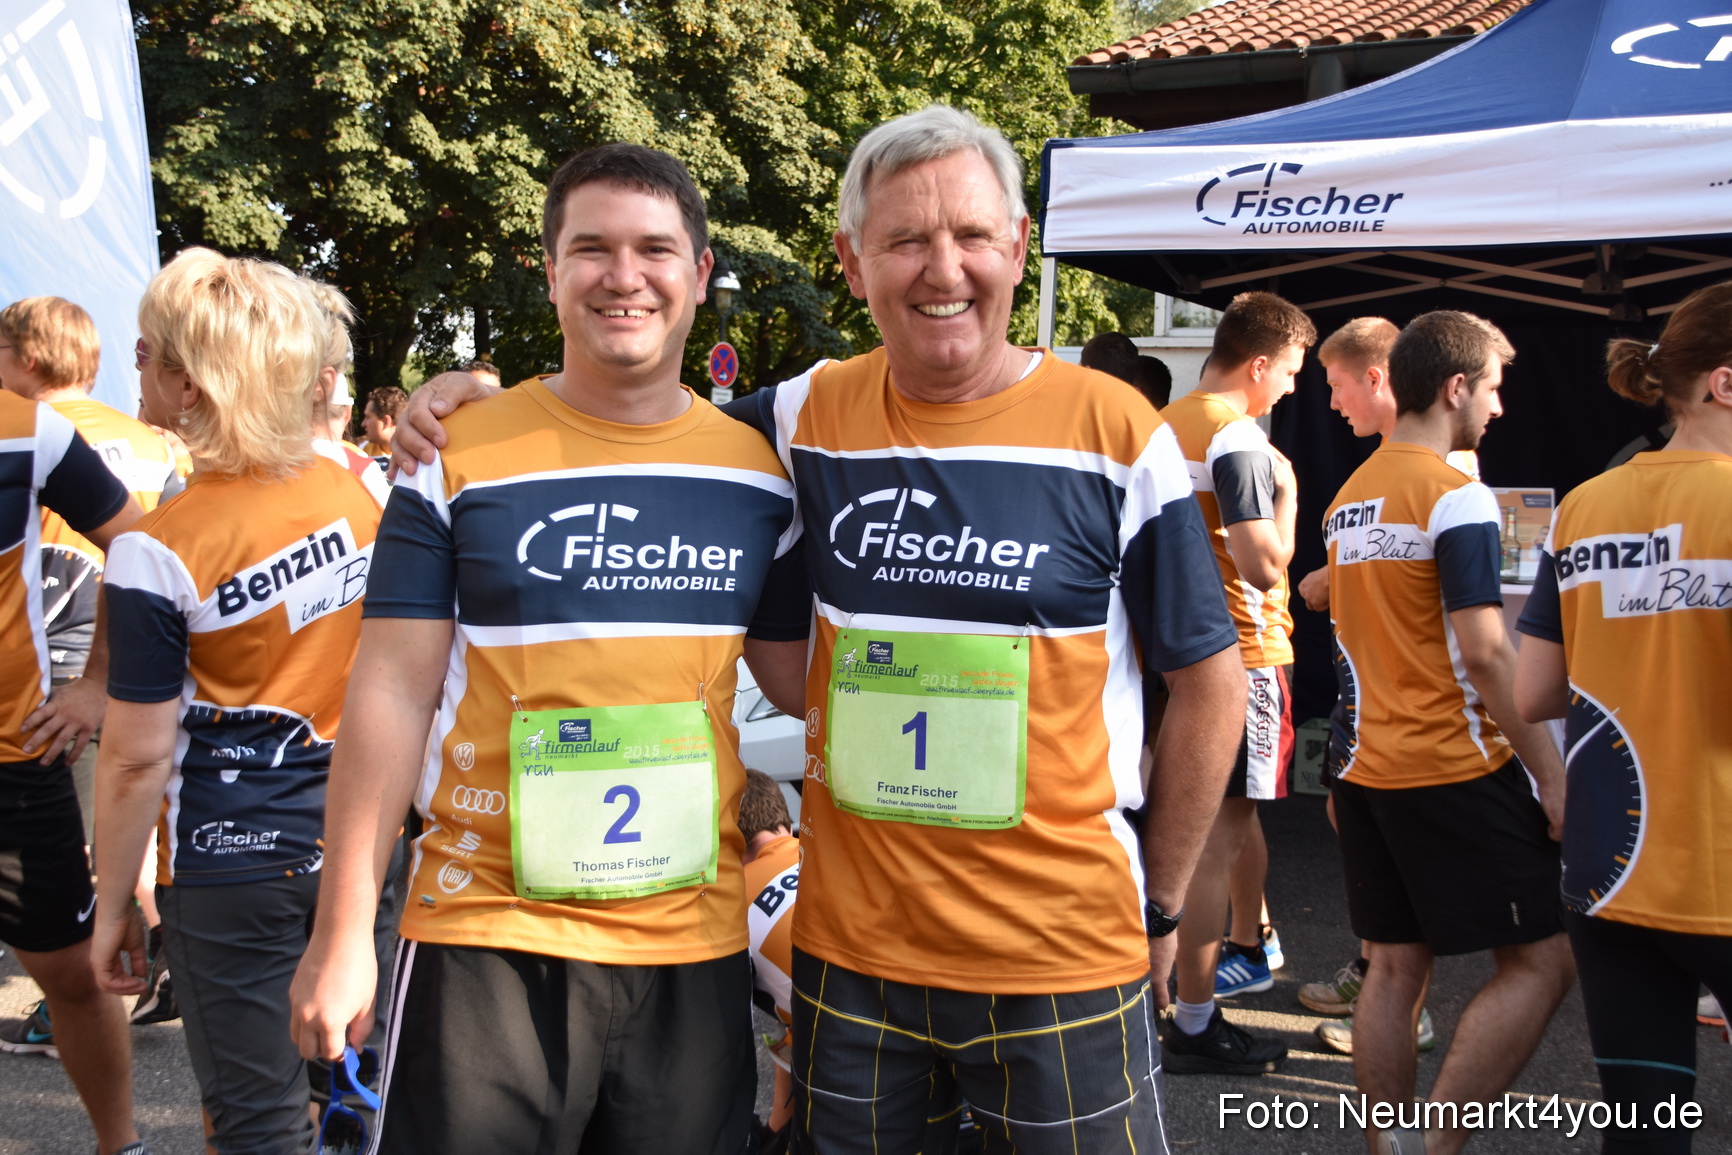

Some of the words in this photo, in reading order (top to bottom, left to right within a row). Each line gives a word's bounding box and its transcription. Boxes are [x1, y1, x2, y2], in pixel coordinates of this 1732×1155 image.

[1230, 187, 1404, 218] Fischer
[1242, 219, 1385, 234] AUTOMOBILE
[562, 536, 743, 571] Fischer
[858, 522, 1049, 569] Fischer
[1360, 528, 1421, 560] Blut
[1554, 532, 1670, 582] Benzin
[217, 530, 347, 618] Benzin
[582, 575, 736, 592] AUTOMOBILE
[872, 566, 1032, 593] AUTOMOBILE
[1618, 593, 1657, 612] im
[854, 660, 919, 678] firmenlauf
[919, 674, 959, 688] 2015
[544, 738, 622, 753] firmenlauf
[623, 744, 660, 759] 2015
[902, 711, 928, 771] 1
[877, 781, 910, 795] Franz
[911, 784, 958, 799] Fischer
[876, 797, 899, 806] Fischer
[900, 800, 935, 810] Automobile
[936, 802, 957, 810] GmbH
[451, 813, 472, 825] Audi
[603, 784, 642, 845] 2
[207, 831, 281, 847] Fischer
[213, 842, 276, 855] AUTOMOBILE
[440, 844, 474, 859] SEAT
[573, 859, 624, 872] Thomas
[626, 855, 671, 869] Fischer
[444, 866, 468, 884] FIAT
[581, 876, 605, 884] Fischer
[607, 873, 643, 882] Automobile
